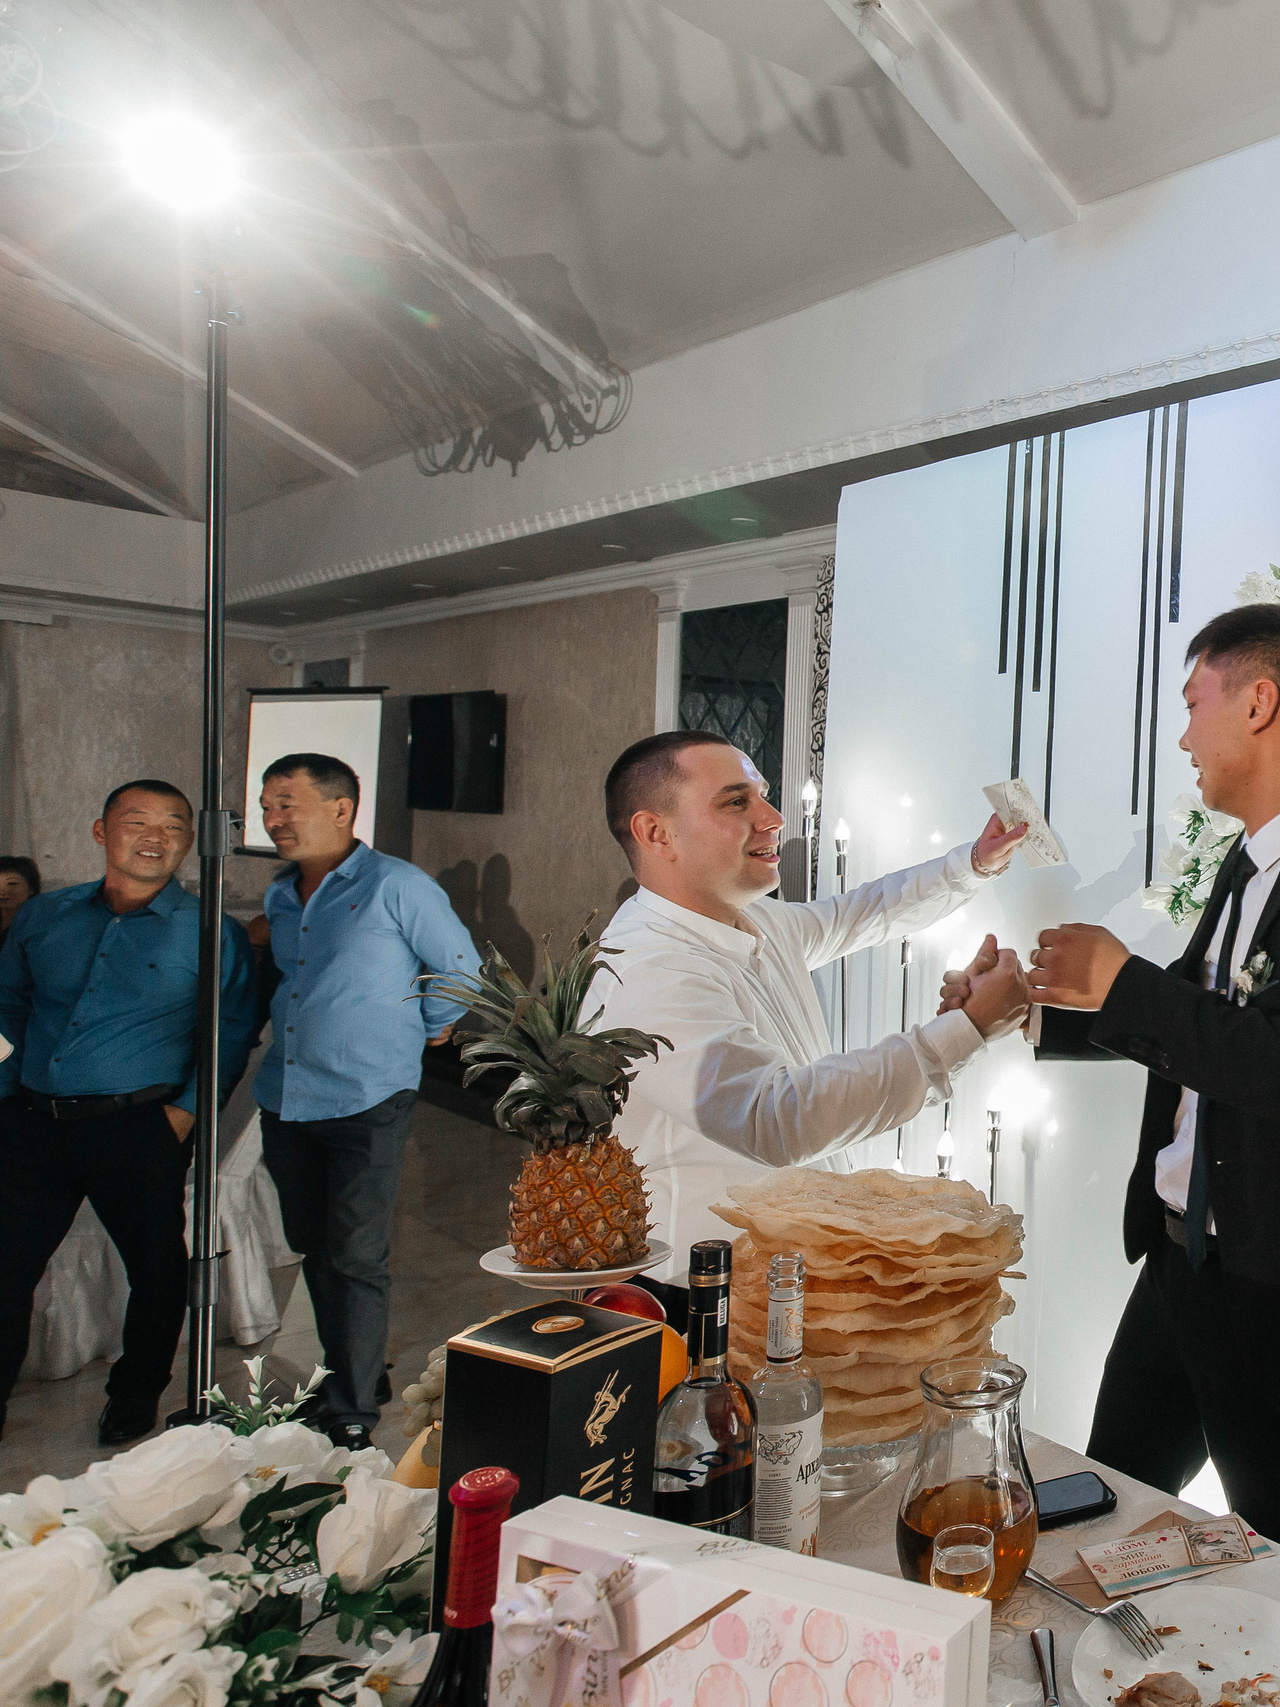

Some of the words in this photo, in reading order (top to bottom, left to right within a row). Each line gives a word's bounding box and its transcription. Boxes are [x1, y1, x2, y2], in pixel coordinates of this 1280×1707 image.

[620, 1447, 635, 1511] GNAC
[1115, 1539, 1151, 1553] ДОМЕ
[1119, 1563, 1170, 1580] ЛЮБОВЬ
